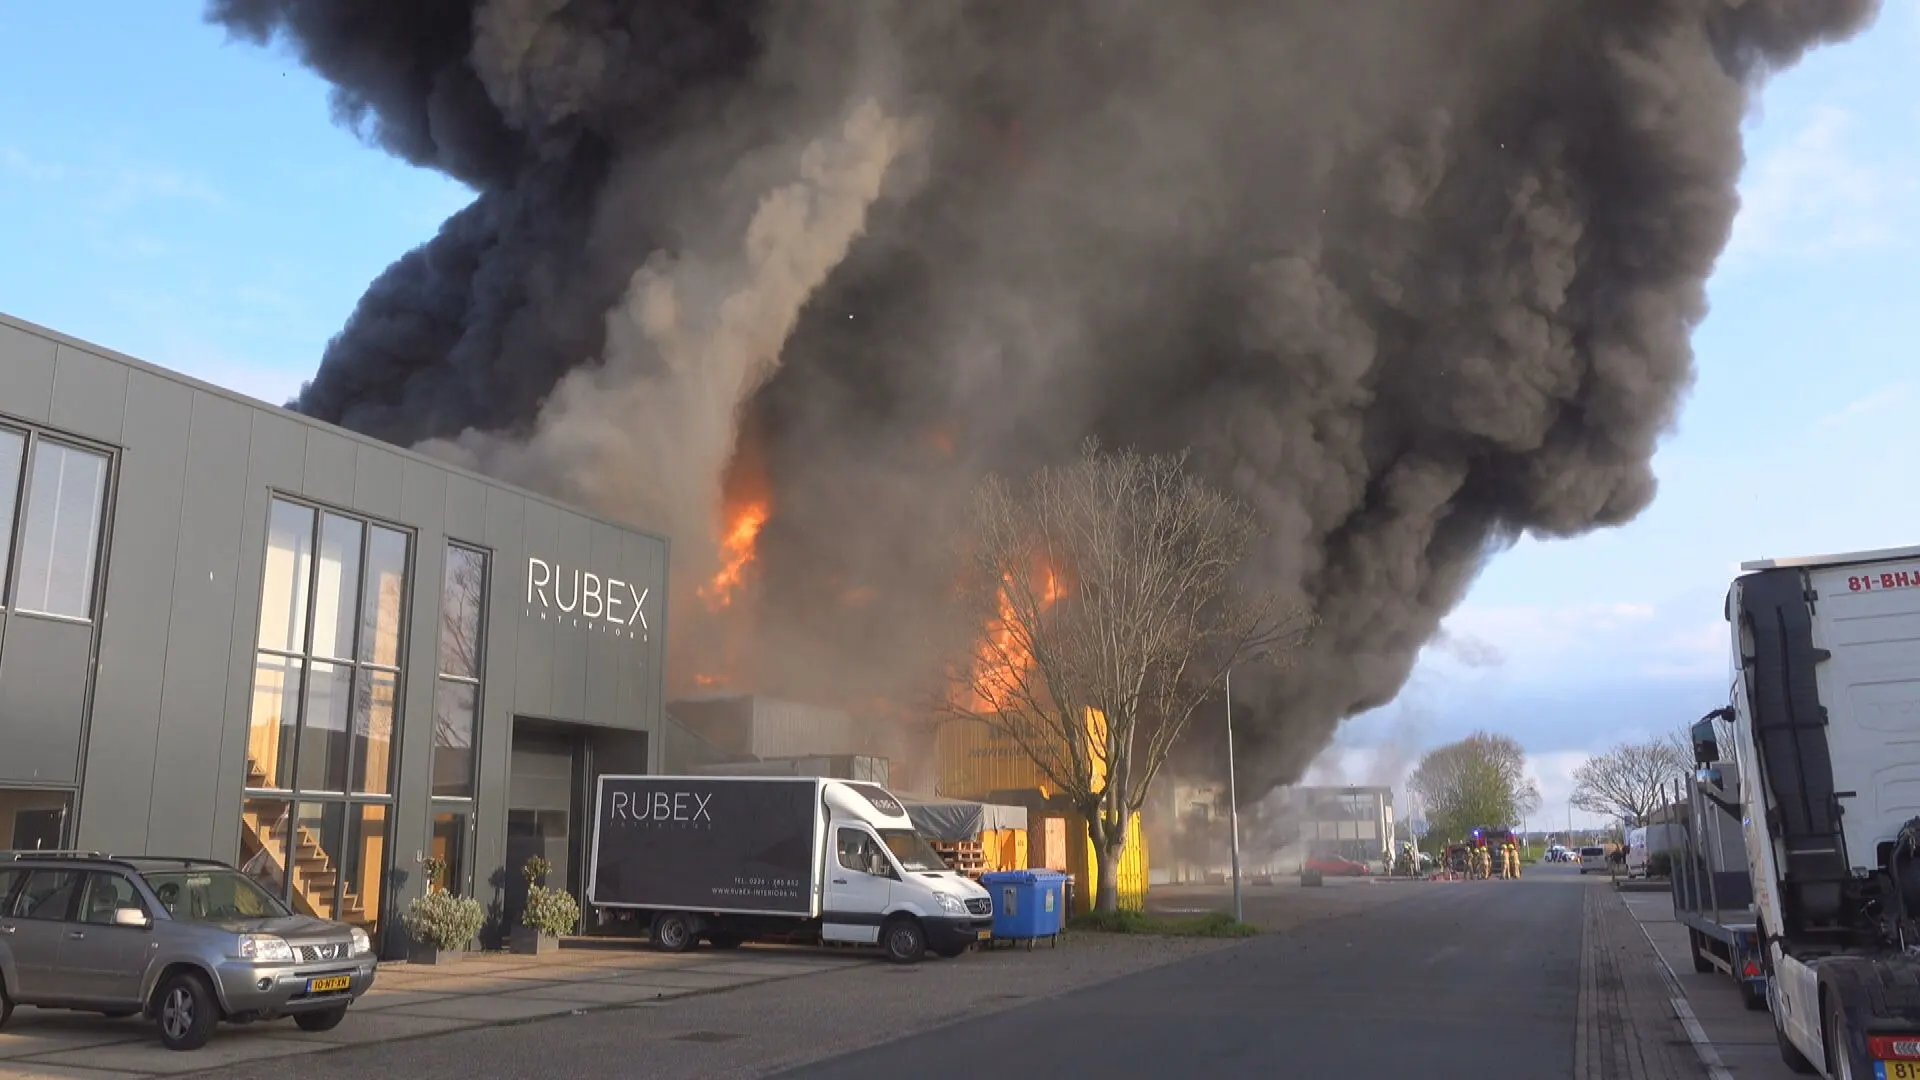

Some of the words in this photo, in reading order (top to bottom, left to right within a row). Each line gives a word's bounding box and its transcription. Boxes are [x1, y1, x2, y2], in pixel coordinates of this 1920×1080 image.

[527, 557, 649, 630] RUBEX
[1848, 570, 1920, 591] 81-BHJ
[526, 608, 648, 643] INTERIORS
[611, 791, 713, 821] RUBEX
